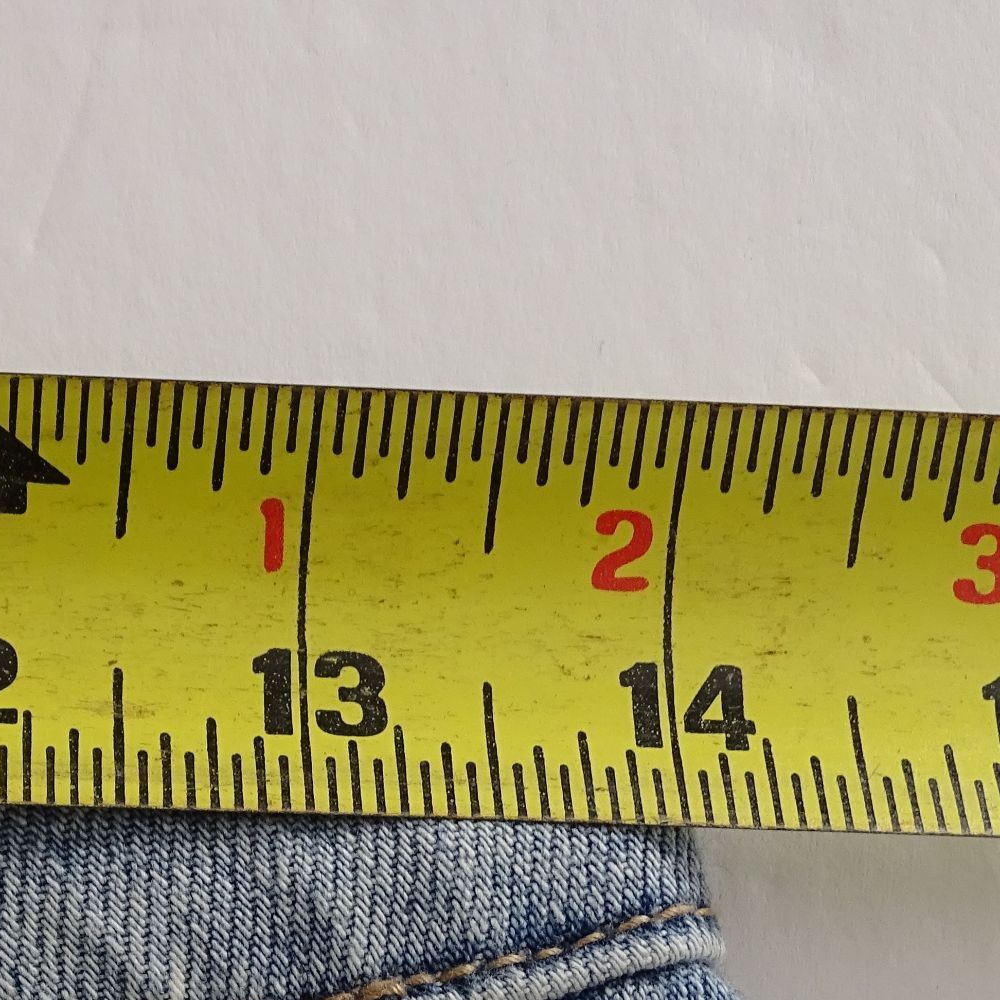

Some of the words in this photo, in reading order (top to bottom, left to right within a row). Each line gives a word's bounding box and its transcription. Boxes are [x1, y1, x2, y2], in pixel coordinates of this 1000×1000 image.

[261, 497, 284, 573] 1
[591, 509, 653, 591] 2
[953, 523, 1000, 604] 3
[252, 647, 387, 737] 13
[619, 661, 756, 751] 14
